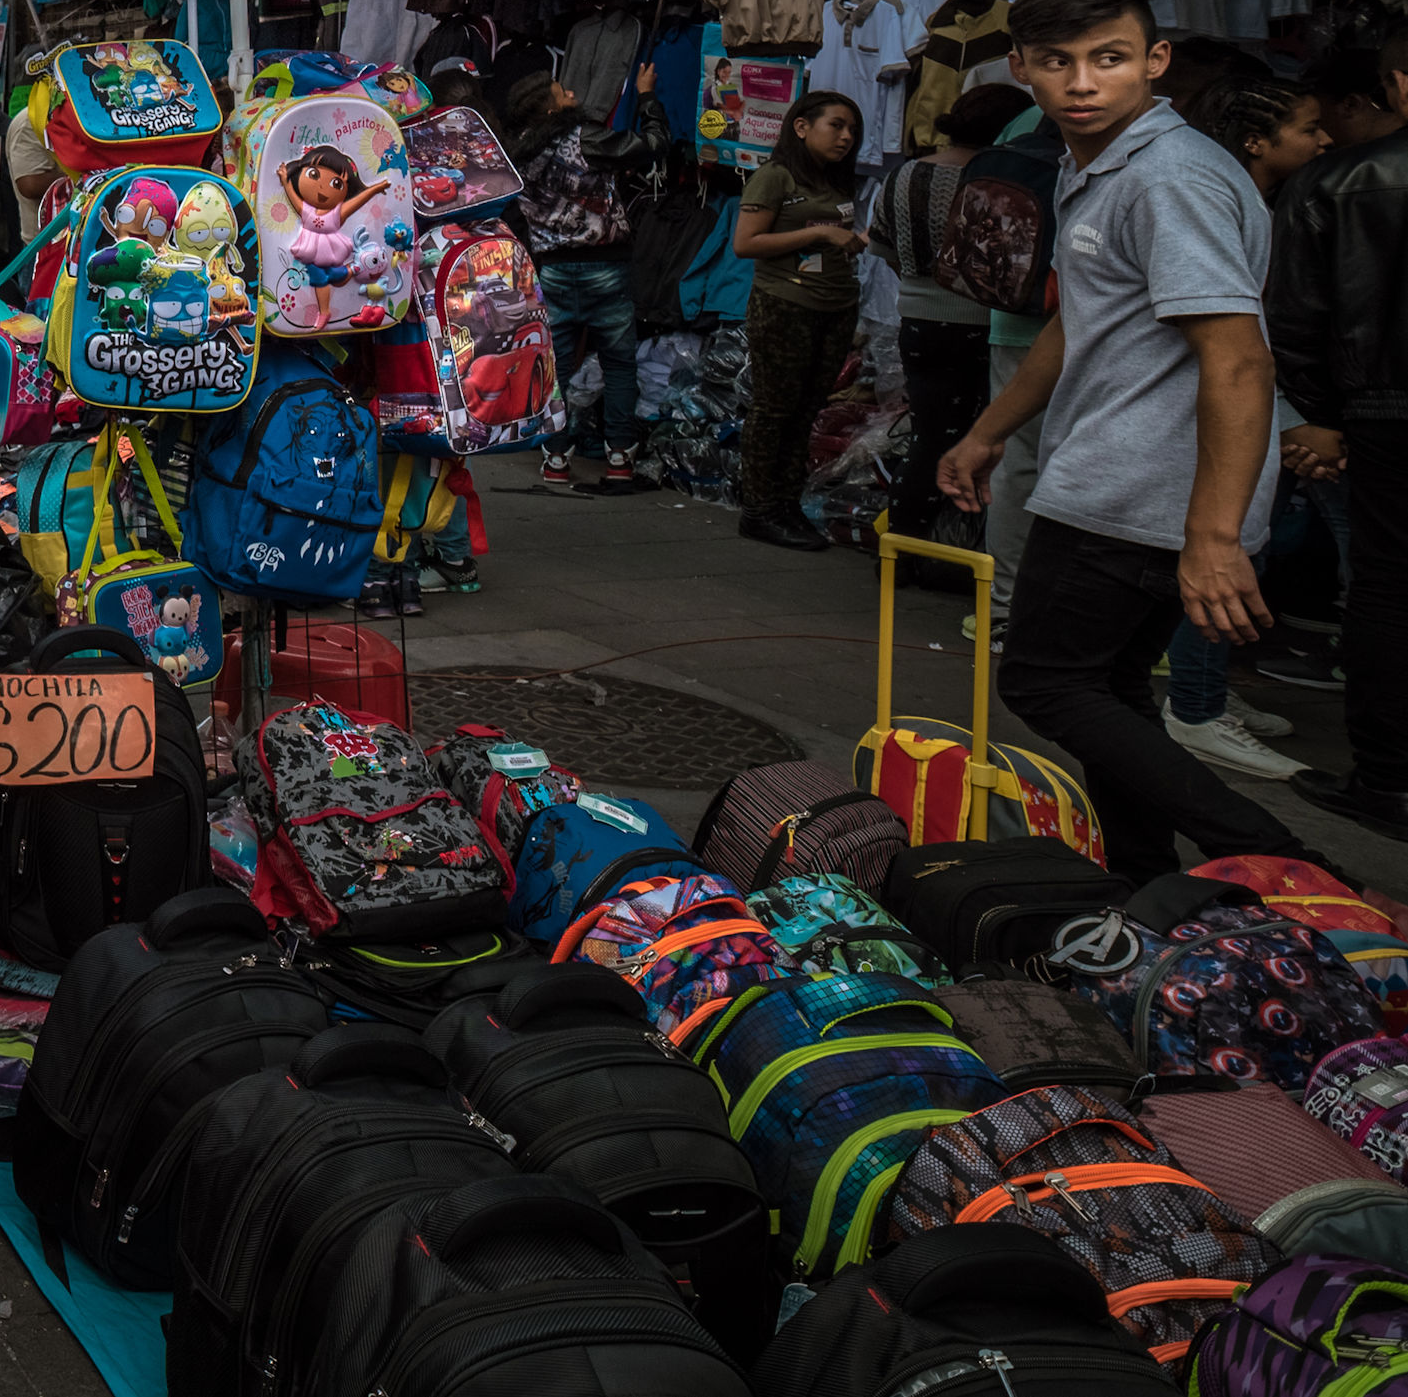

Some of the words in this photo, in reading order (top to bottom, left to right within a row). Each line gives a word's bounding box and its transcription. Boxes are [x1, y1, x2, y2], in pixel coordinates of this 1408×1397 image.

[110, 103, 181, 126] Grossery
[154, 112, 189, 133] GANG
[87, 334, 227, 375] Grossery
[162, 364, 235, 395] GANG
